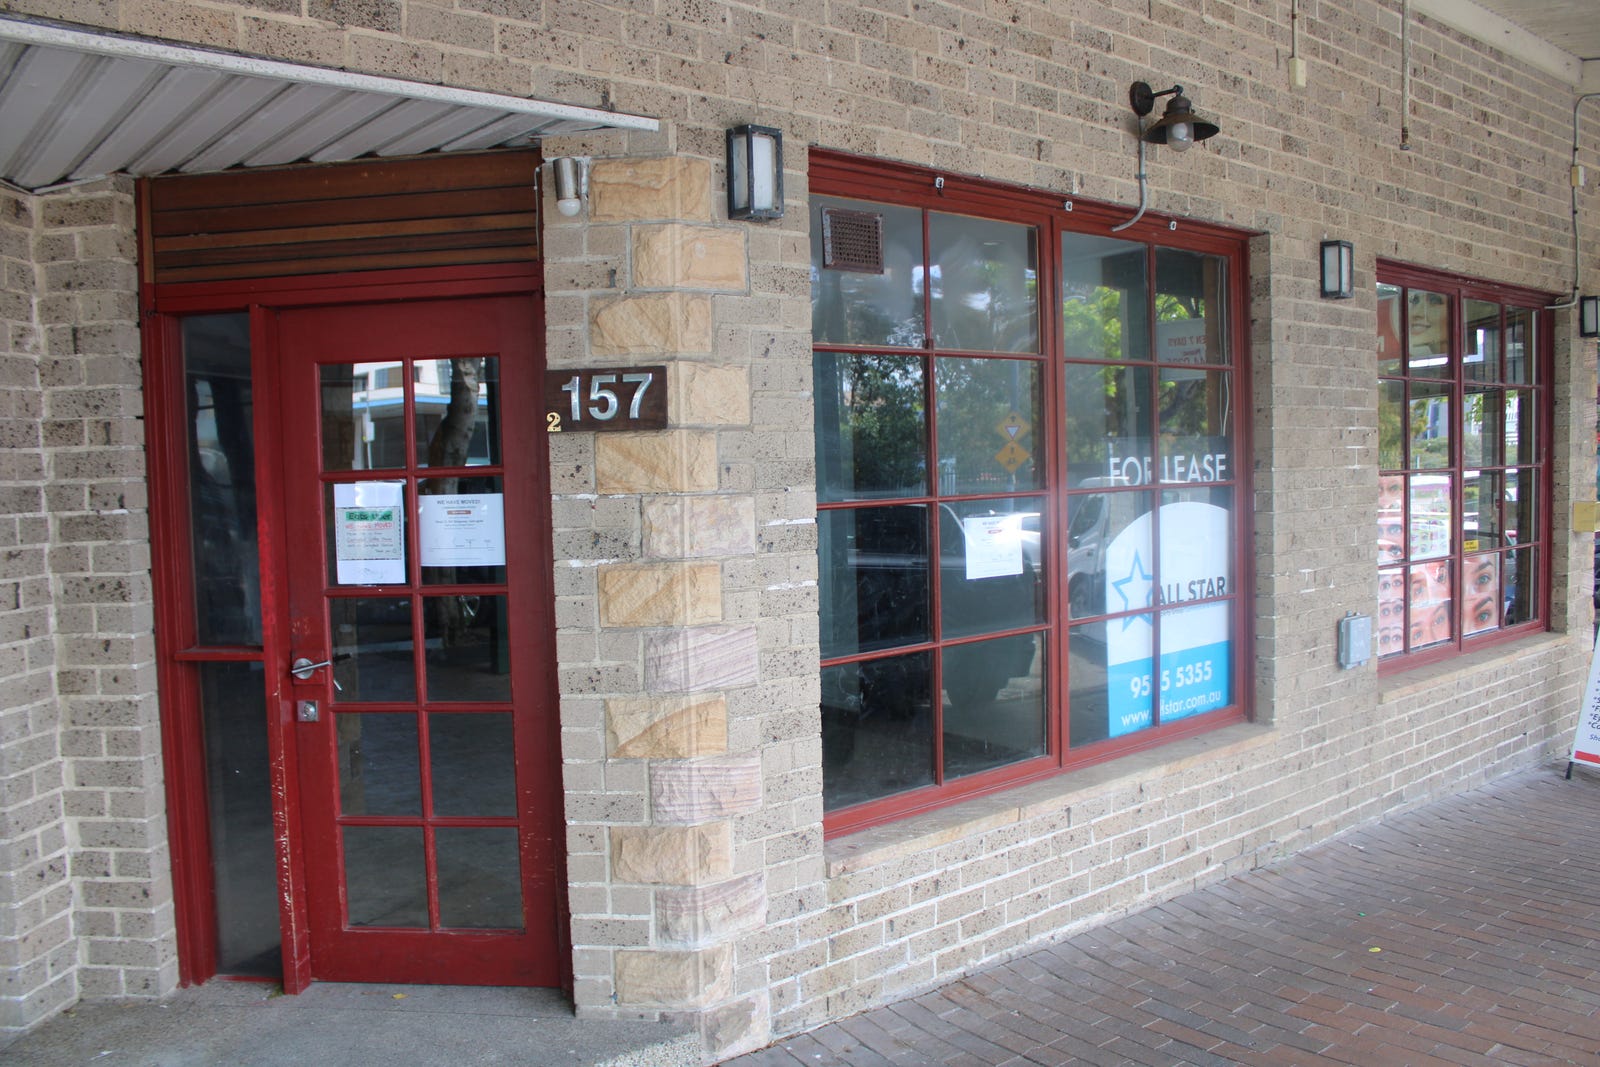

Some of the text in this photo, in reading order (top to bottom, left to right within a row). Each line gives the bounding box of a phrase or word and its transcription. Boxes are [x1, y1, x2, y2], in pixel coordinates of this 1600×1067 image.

[561, 373, 652, 421] 157
[546, 412, 561, 432] 2
[1163, 454, 1226, 483] LEASE
[1188, 576, 1226, 602] STAR
[1130, 660, 1213, 699] 955 5355
[1121, 691, 1221, 726] www.llstar.com.au
